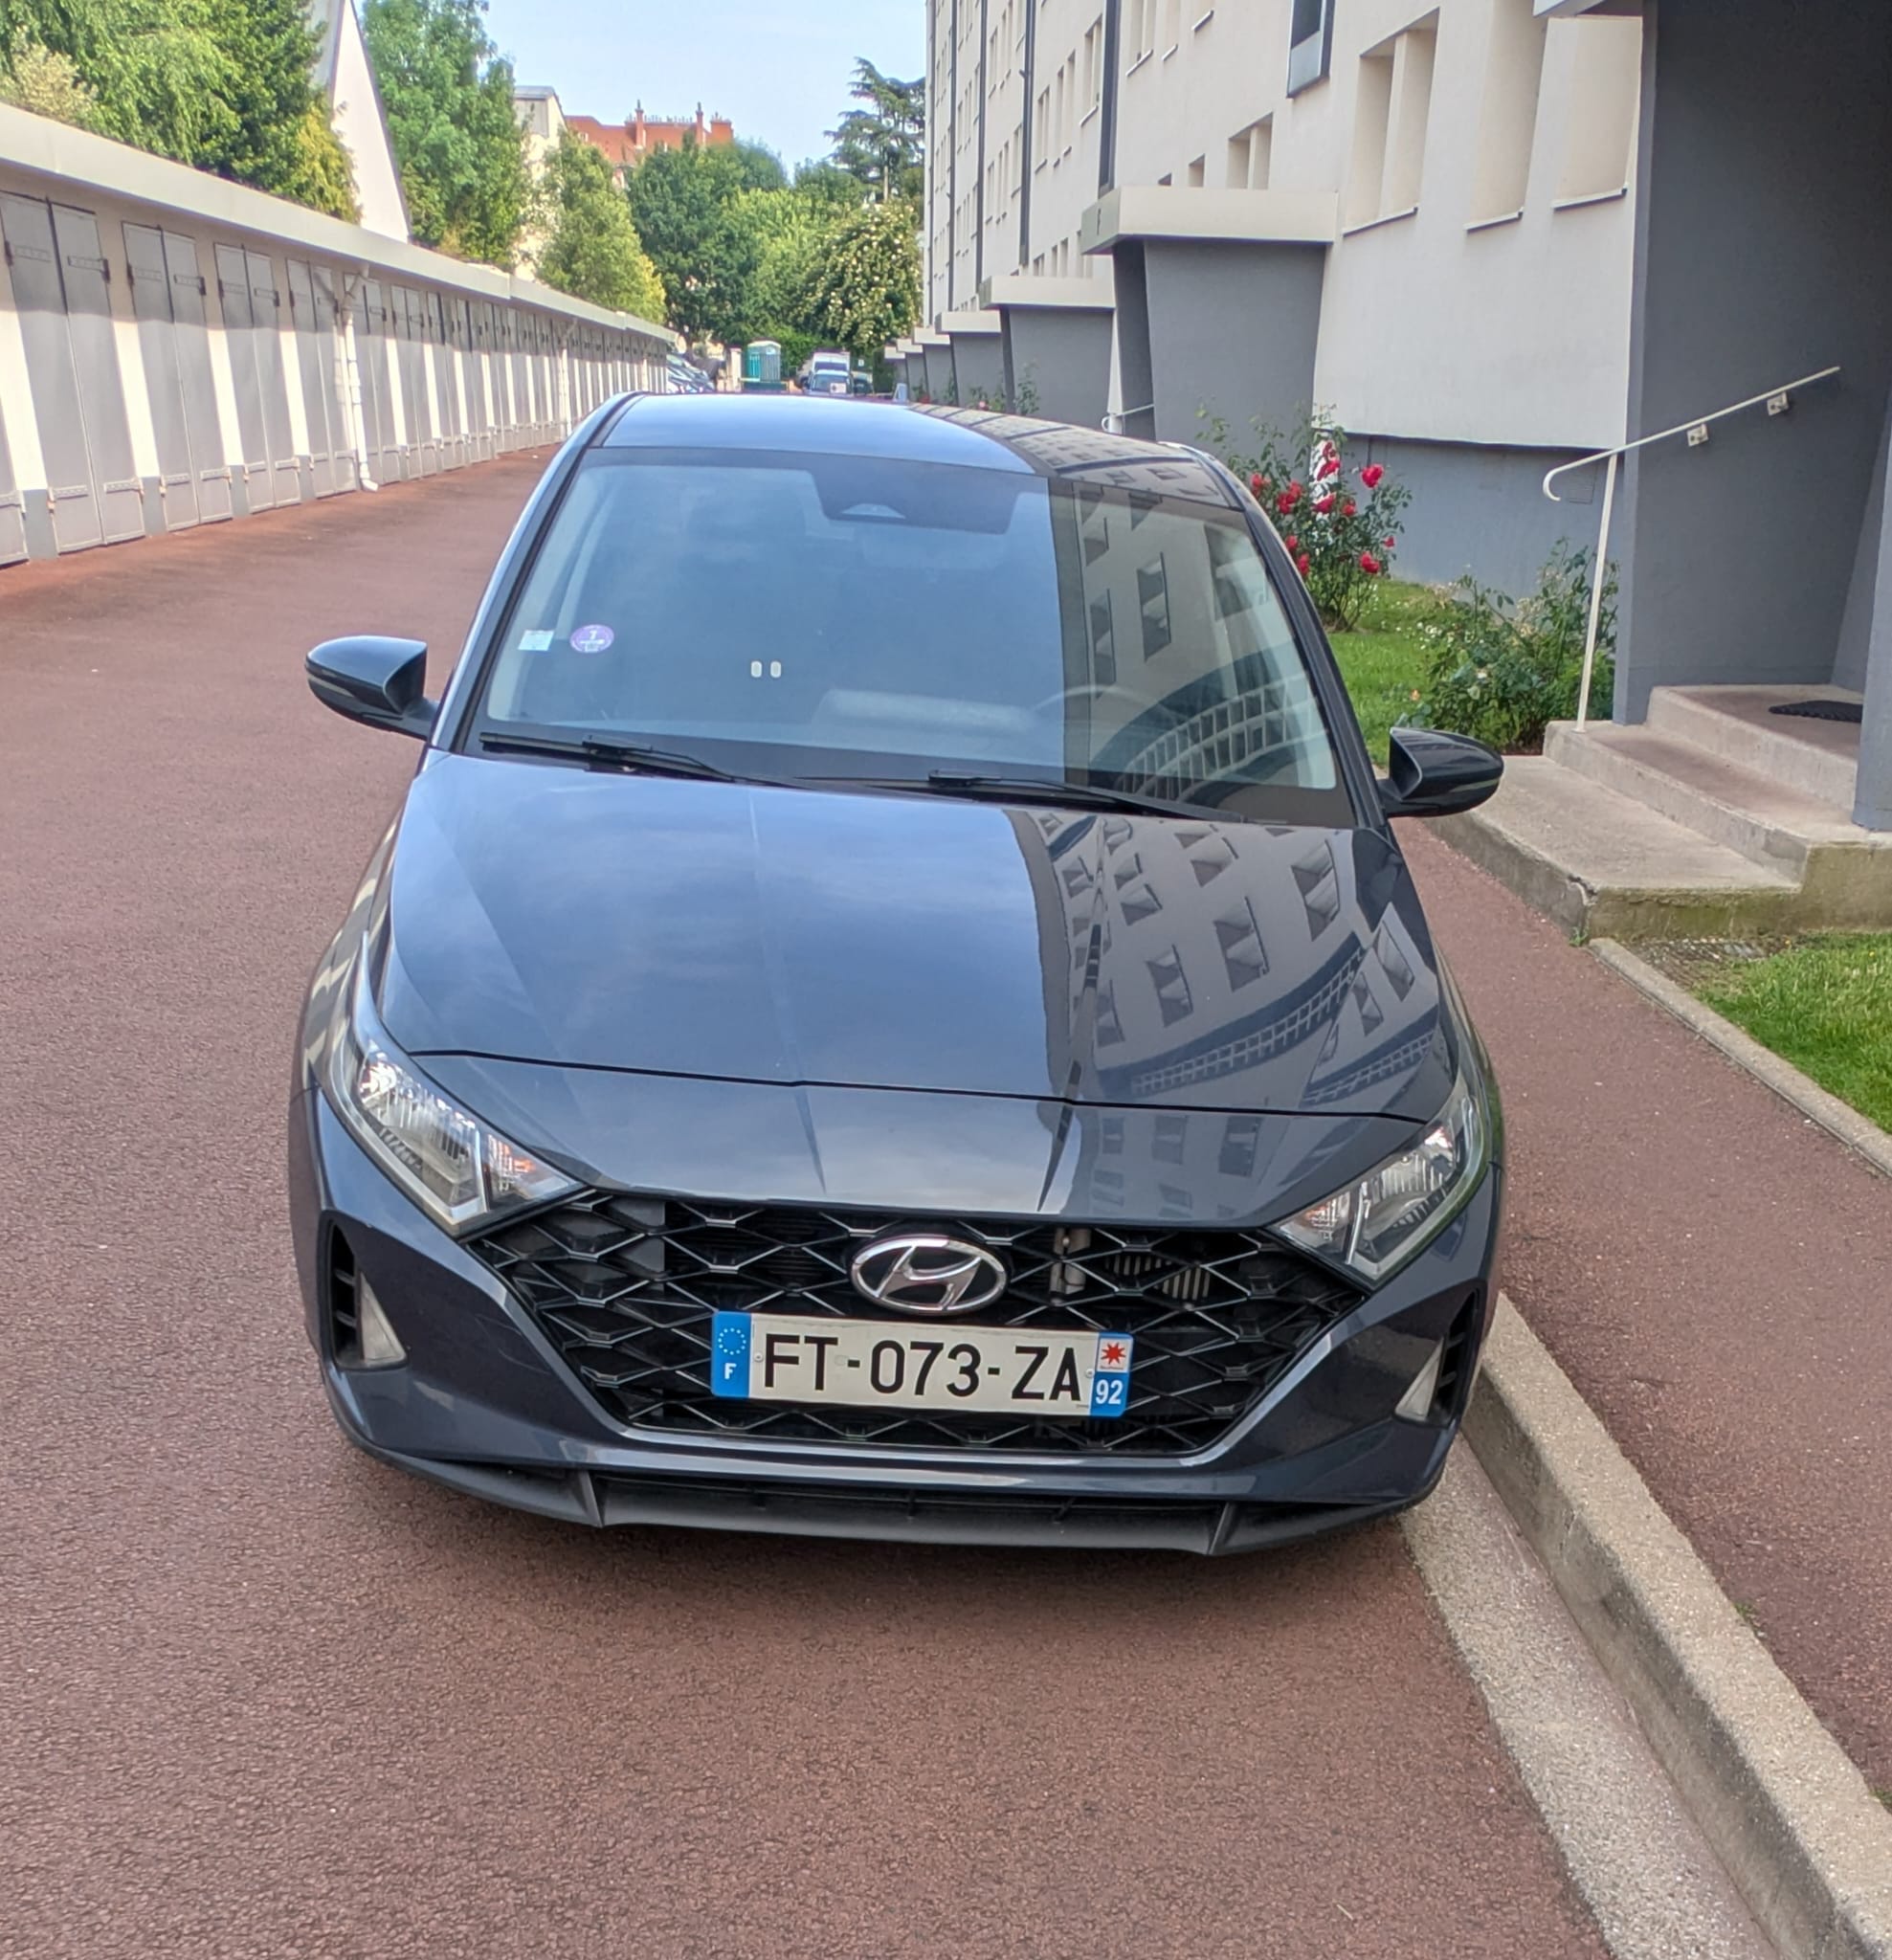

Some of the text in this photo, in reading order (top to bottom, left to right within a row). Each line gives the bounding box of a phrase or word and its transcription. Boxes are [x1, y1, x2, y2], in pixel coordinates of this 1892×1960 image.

[724, 1362, 737, 1379] F
[765, 1333, 1080, 1403] FT-073-ZA
[1096, 1379, 1123, 1404] 92
